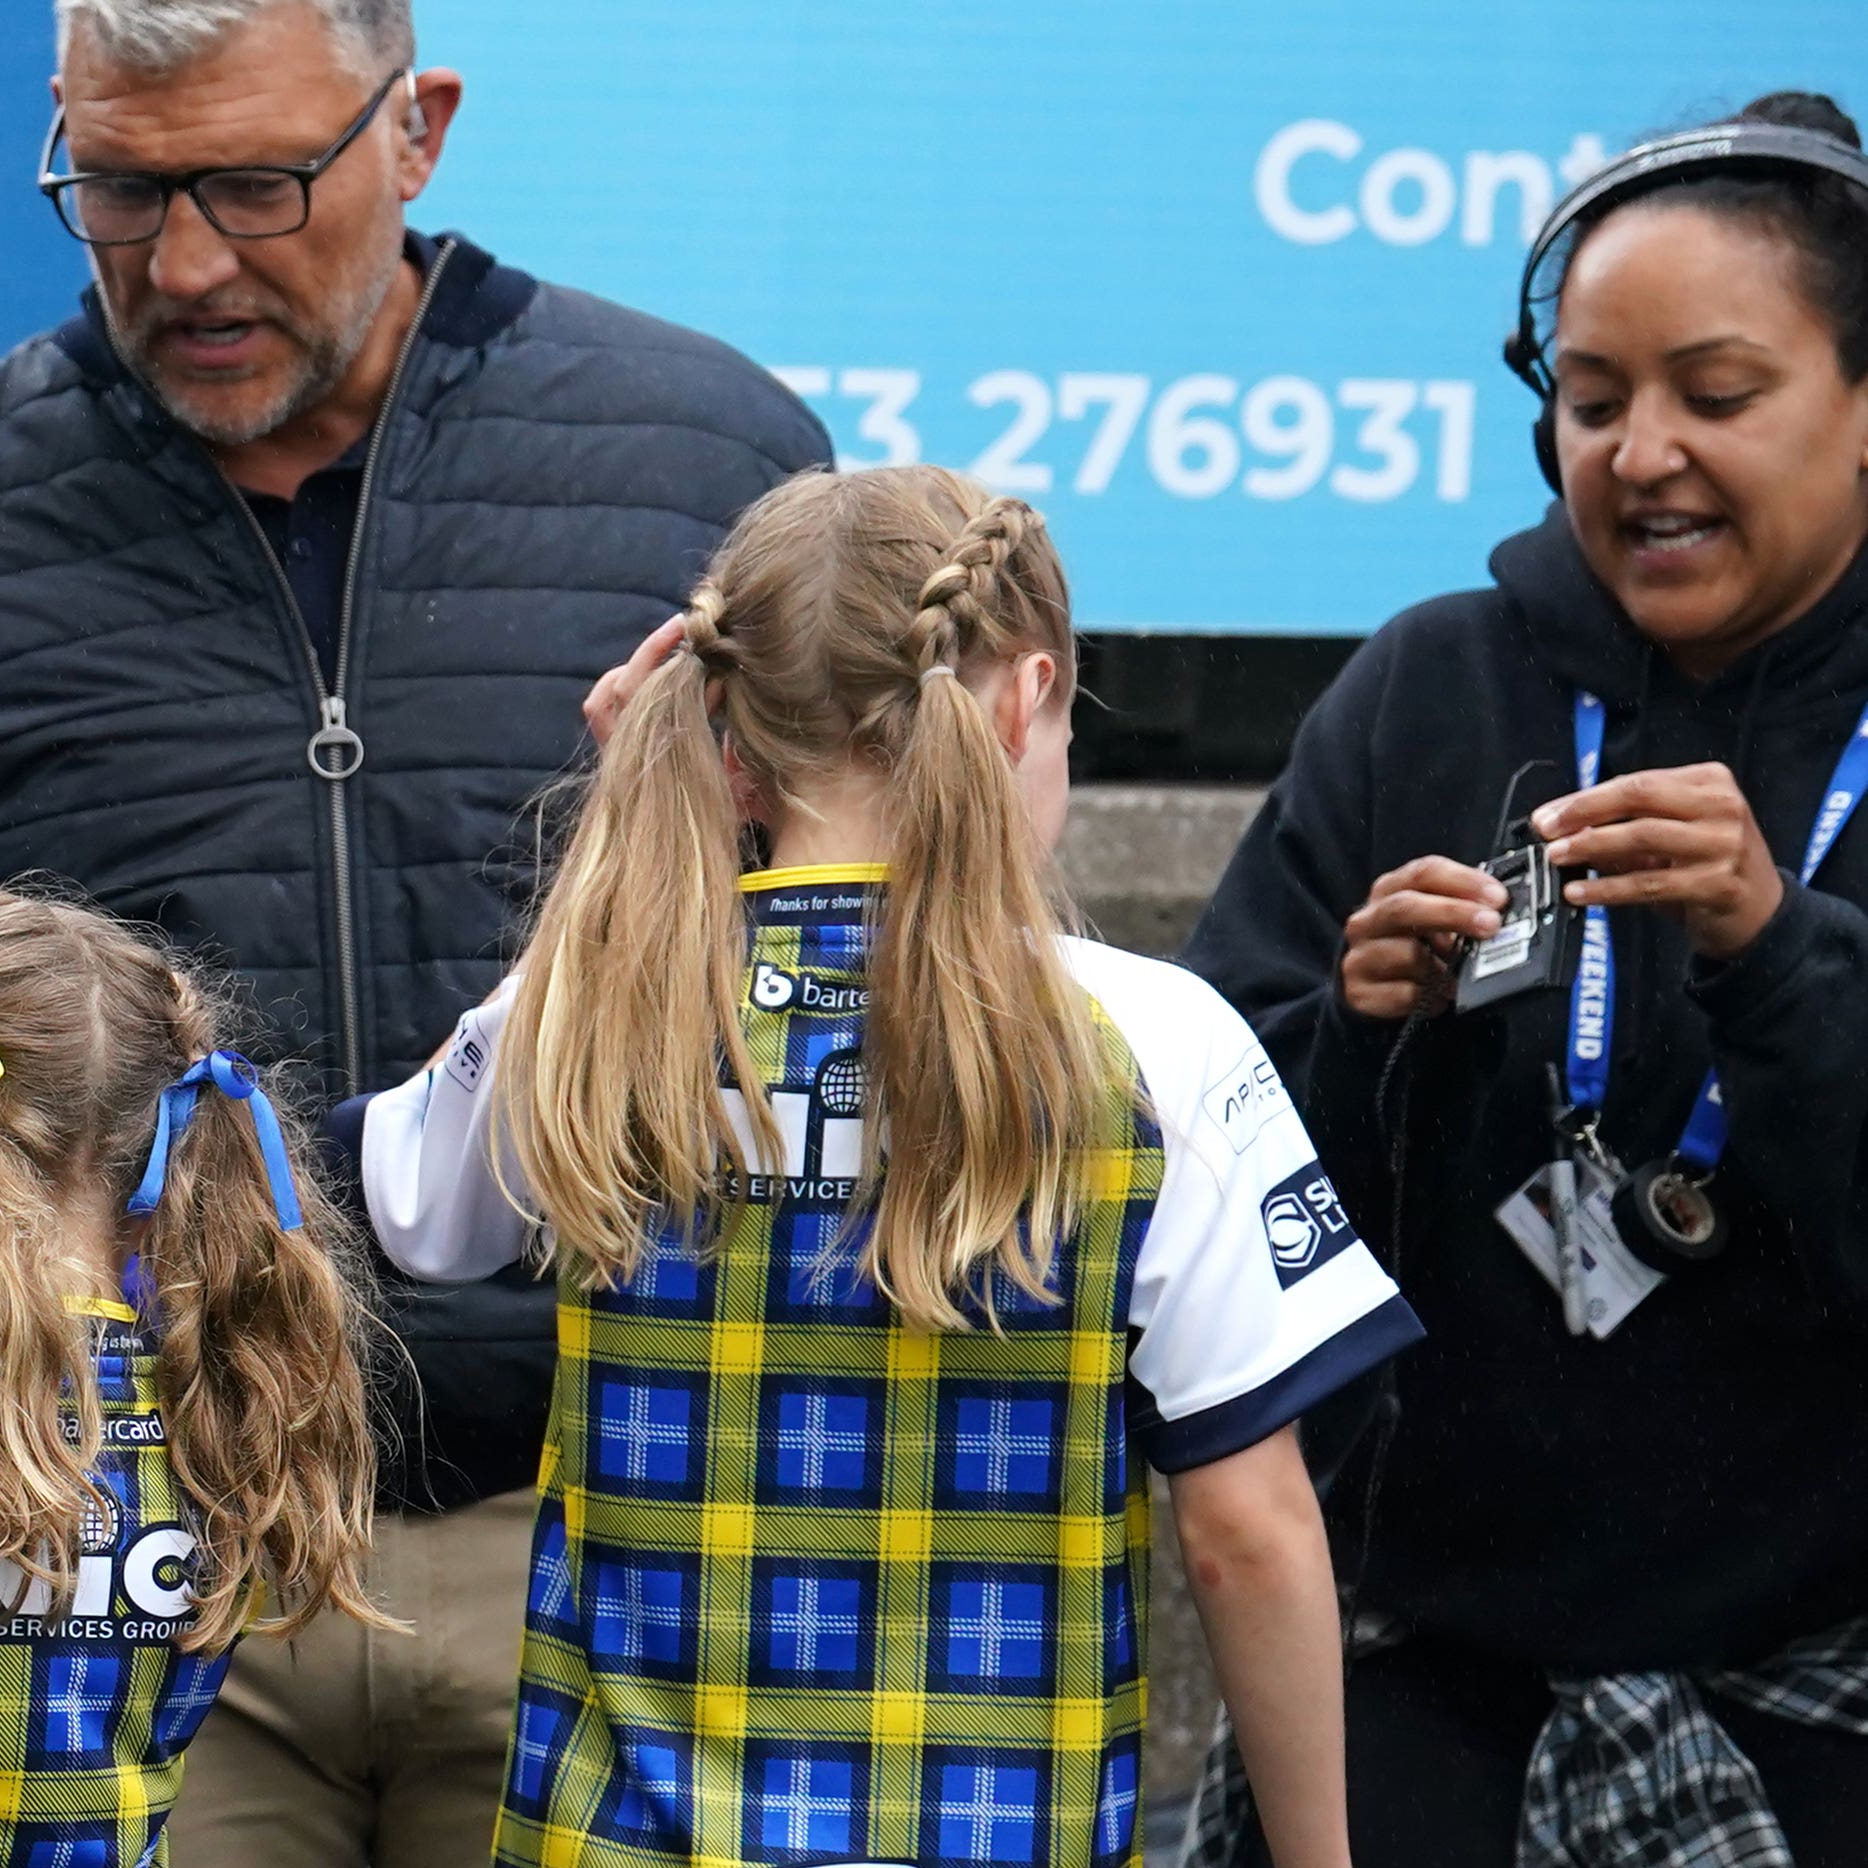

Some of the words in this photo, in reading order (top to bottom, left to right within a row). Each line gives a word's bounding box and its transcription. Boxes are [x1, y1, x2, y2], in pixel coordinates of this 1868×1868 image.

[966, 367, 1477, 503] 276931
[770, 897, 809, 912] Thanks
[812, 896, 828, 911] for
[1575, 917, 1608, 1061] WEEKEND
